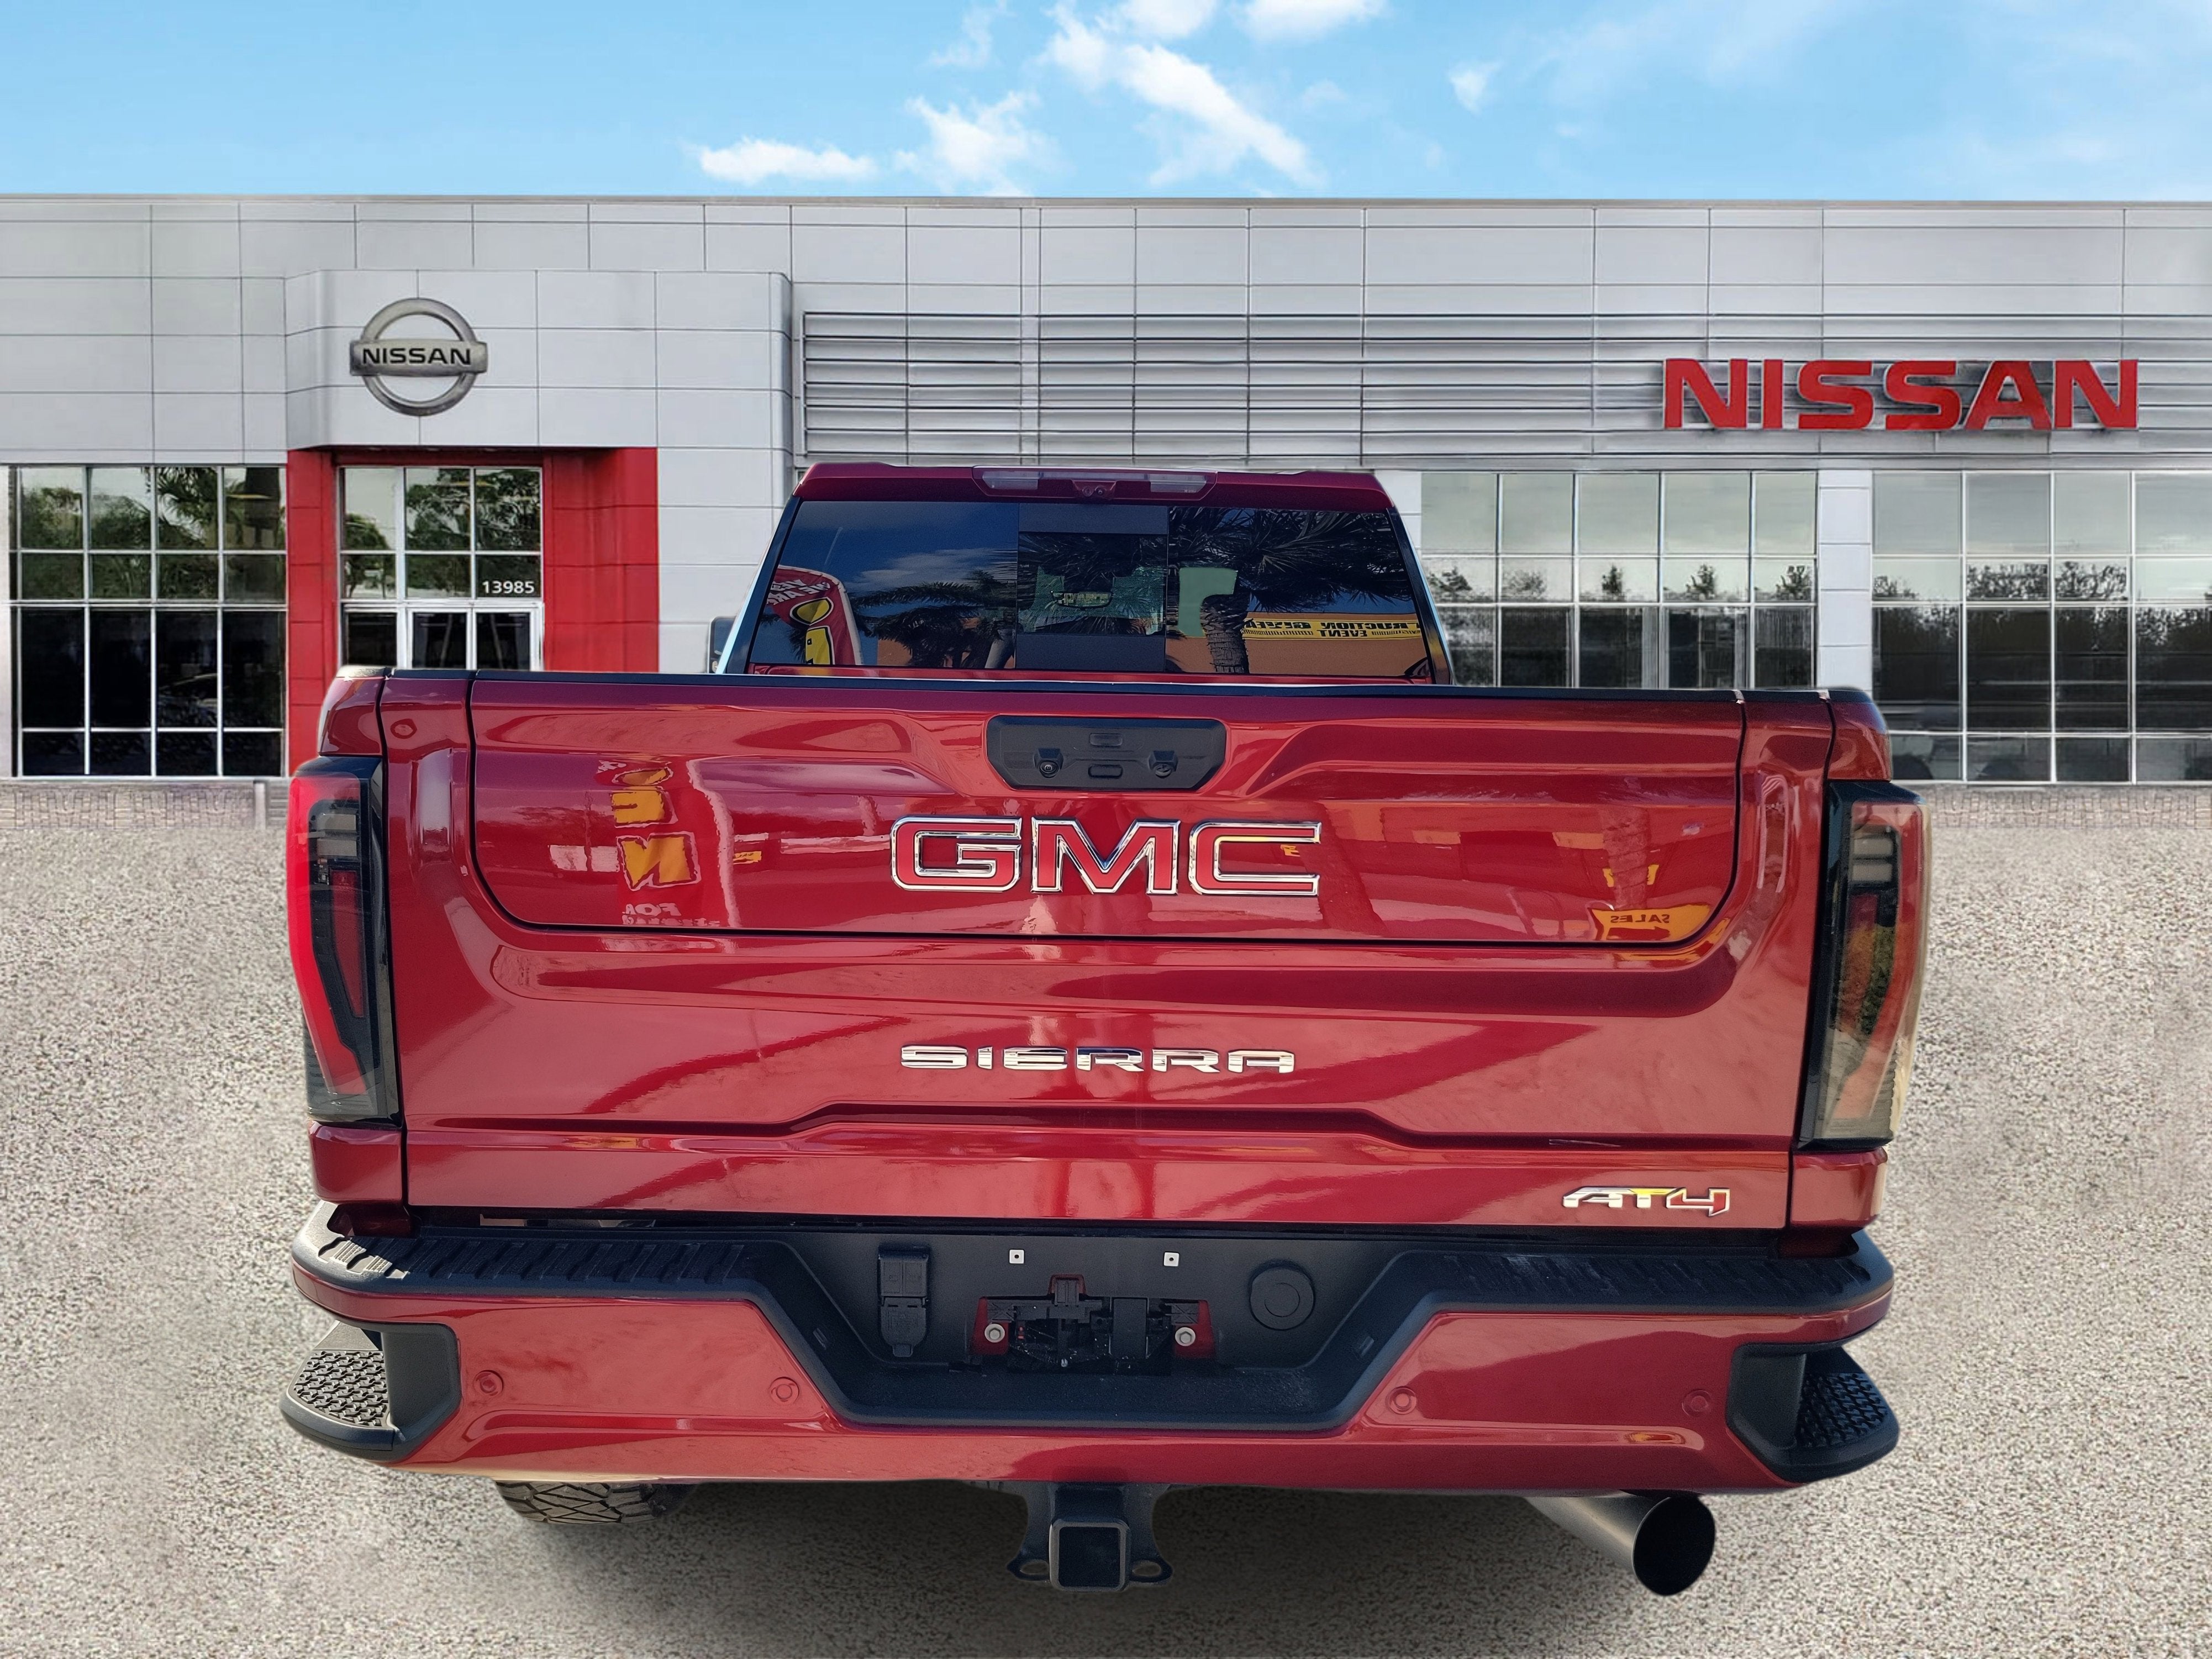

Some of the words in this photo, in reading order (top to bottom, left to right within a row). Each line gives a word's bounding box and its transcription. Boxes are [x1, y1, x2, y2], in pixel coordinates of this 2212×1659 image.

[361, 347, 472, 366] NISSAN
[1663, 358, 2139, 431] NISSAN
[482, 580, 535, 594] 13985
[891, 816, 1322, 896] GMC
[900, 1044, 1296, 1074] SIERRA
[1562, 1186, 1730, 1217] AT4
